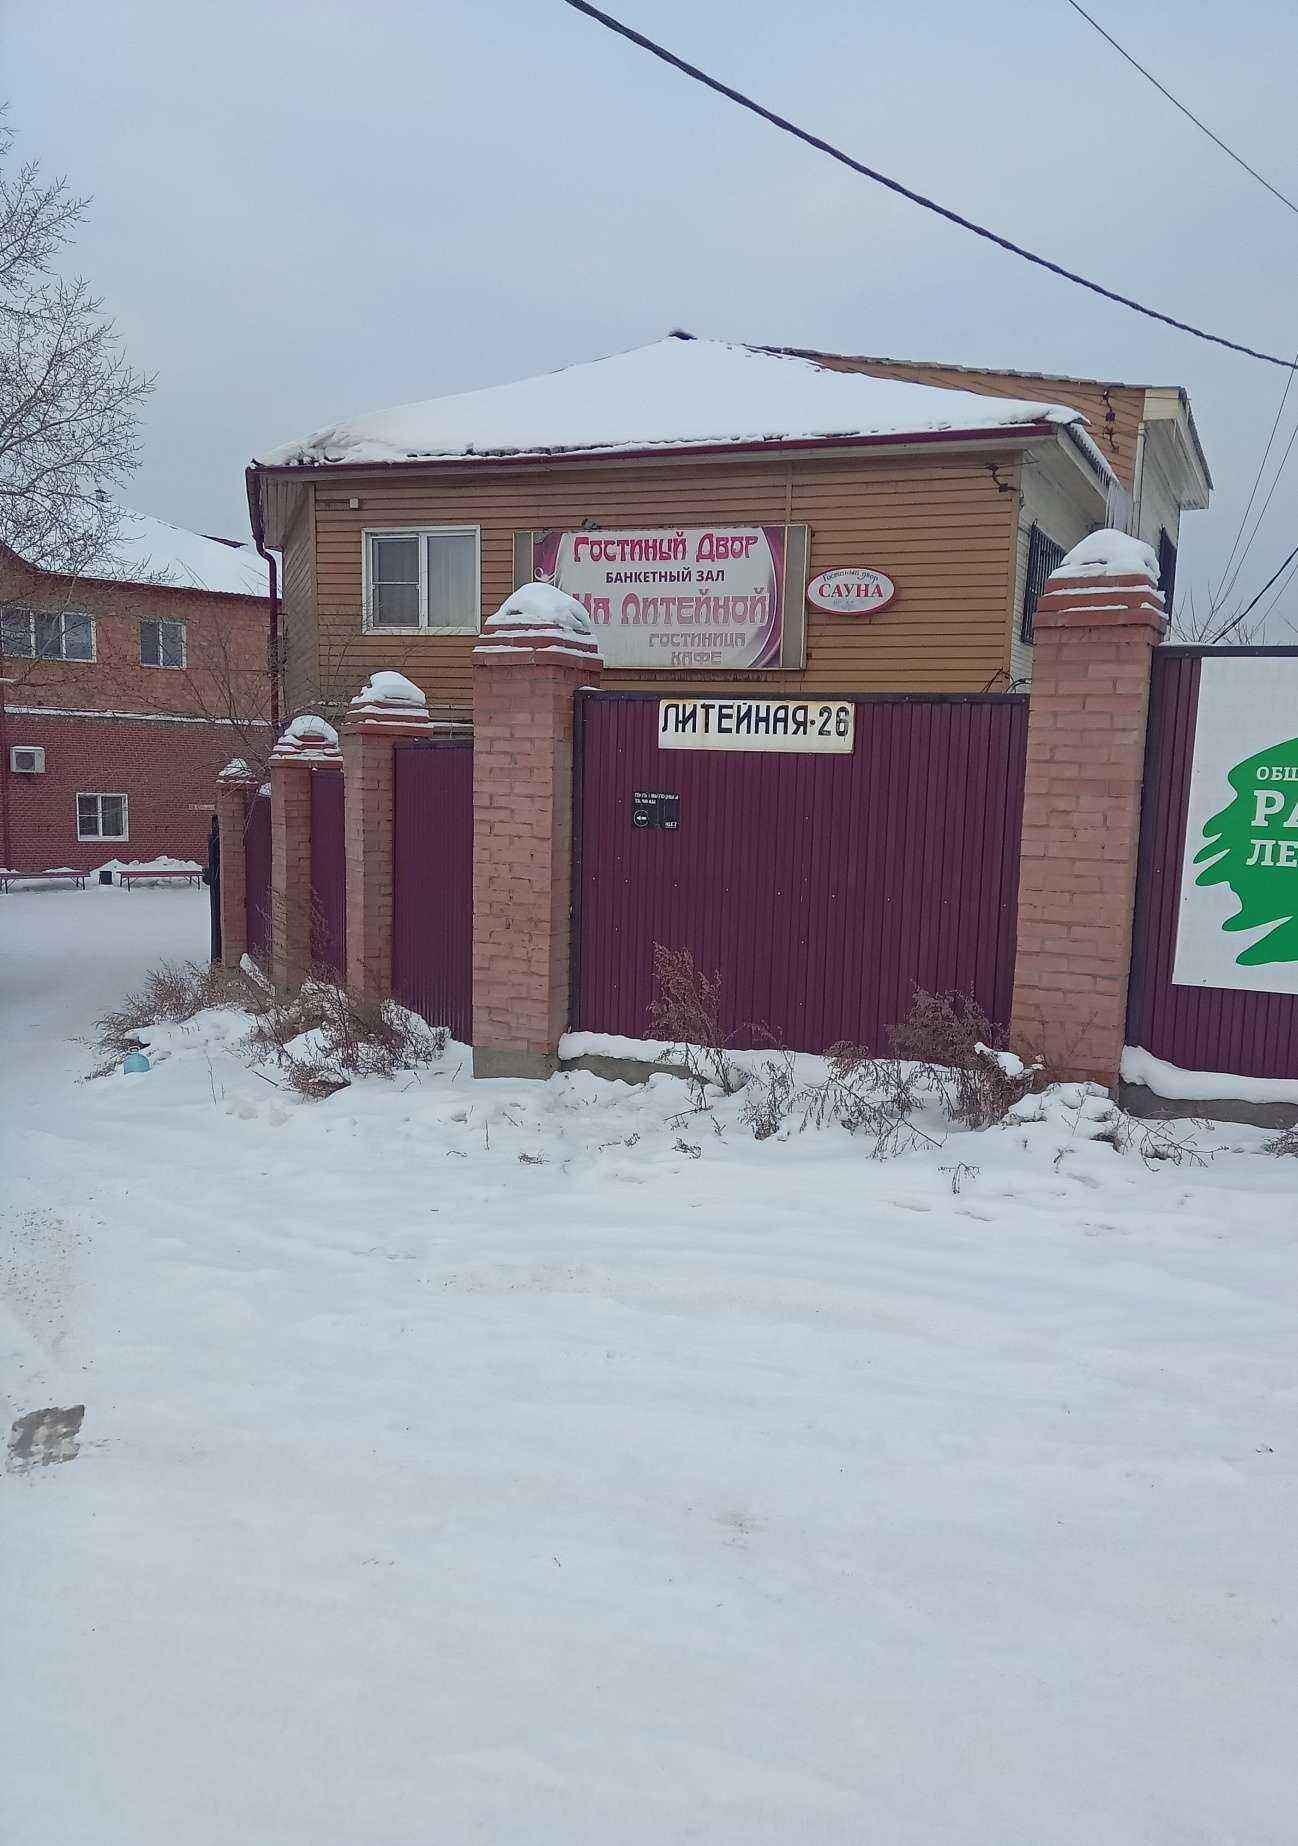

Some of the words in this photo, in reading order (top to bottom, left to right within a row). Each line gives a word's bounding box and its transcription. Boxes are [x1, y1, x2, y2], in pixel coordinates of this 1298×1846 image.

[573, 531, 687, 563] ГОСТИНЫЙ
[696, 533, 759, 563] ДВОР
[605, 567, 692, 584] БАНКЕТНЫЙ
[696, 570, 725, 582] ЗАЛ
[818, 583, 883, 598] САУНА
[621, 587, 770, 626] ЛИТЕЙНОЙ
[649, 632, 746, 648] ГОСТИНИЦА
[671, 651, 722, 666] КАФЕ
[1245, 839, 1298, 868] ЛЕ
